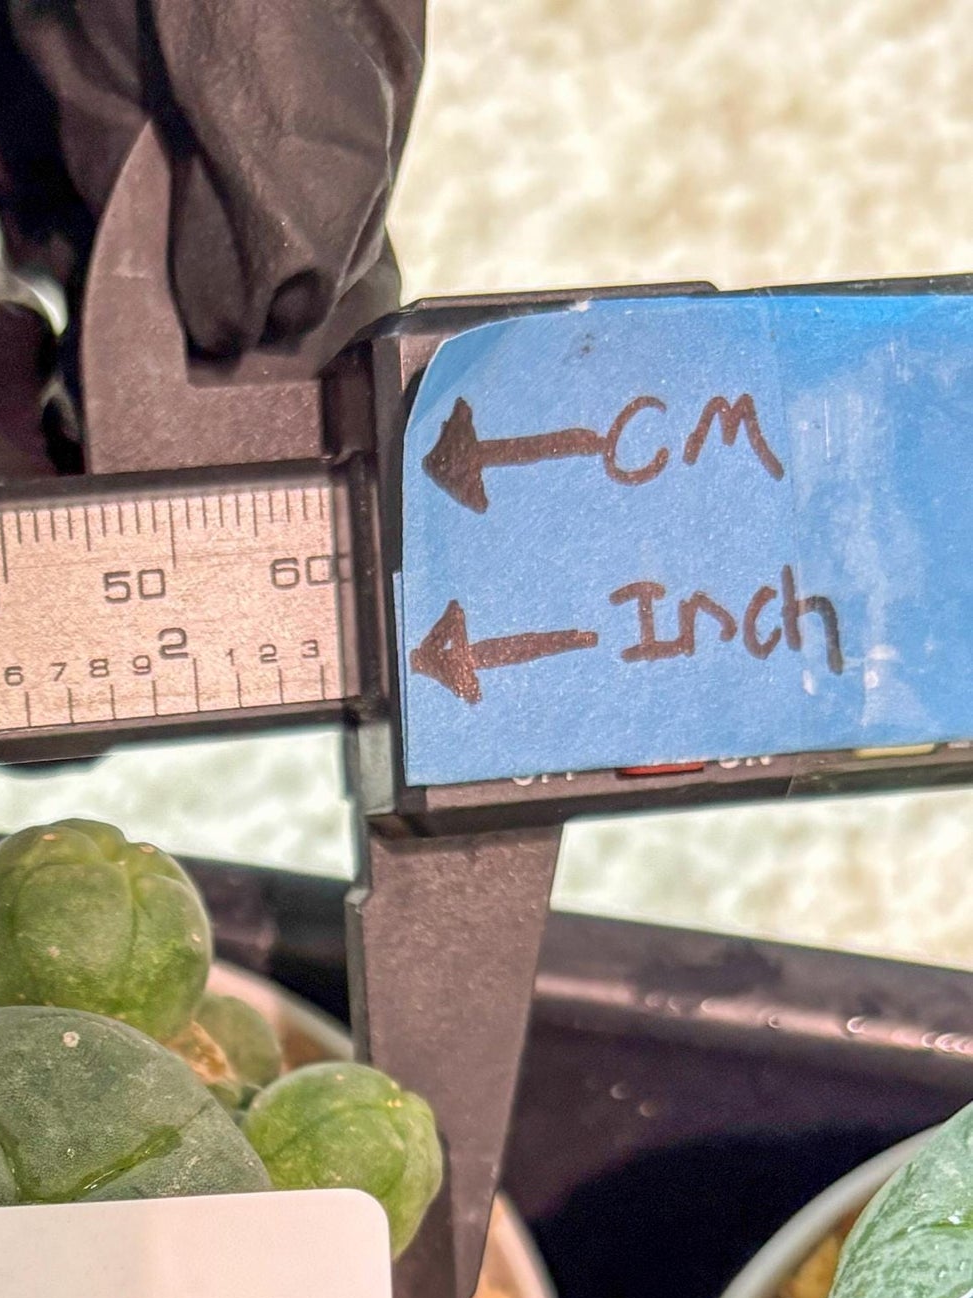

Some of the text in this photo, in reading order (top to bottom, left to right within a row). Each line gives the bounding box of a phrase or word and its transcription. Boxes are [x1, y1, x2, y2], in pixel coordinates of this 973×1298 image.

[103, 568, 167, 604] 50
[270, 555, 334, 590] 60
[609, 564, 844, 675] Inch
[4, 665, 25, 686] 6
[50, 662, 68, 682] 7
[89, 658, 110, 679] 8
[132, 655, 152, 676] 9
[158, 627, 189, 660] 2
[226, 648, 236, 667] 1
[259, 644, 278, 664] 2
[301, 639, 320, 659] 3
